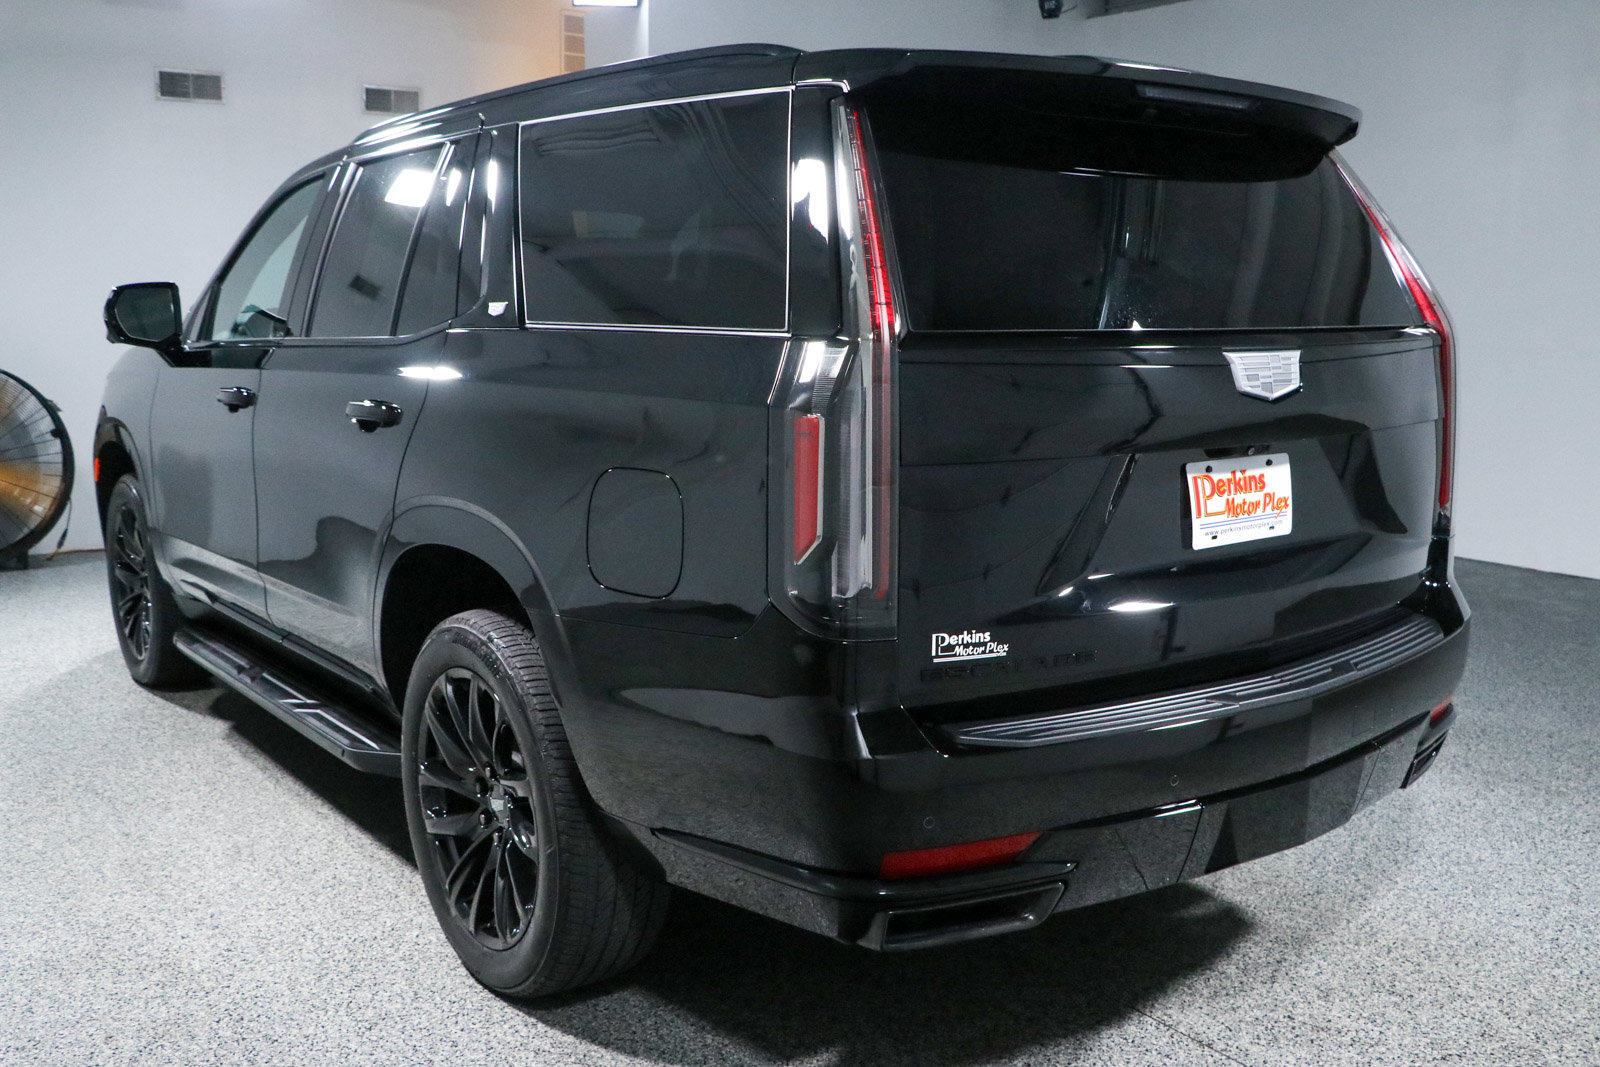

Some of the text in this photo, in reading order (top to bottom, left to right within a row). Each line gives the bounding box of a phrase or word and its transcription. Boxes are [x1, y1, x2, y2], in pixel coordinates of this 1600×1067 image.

[1192, 469, 1266, 518] Perkins
[1225, 491, 1290, 518] Motor Plex
[931, 630, 991, 656] Perkins
[954, 642, 1009, 656] Motor Plex
